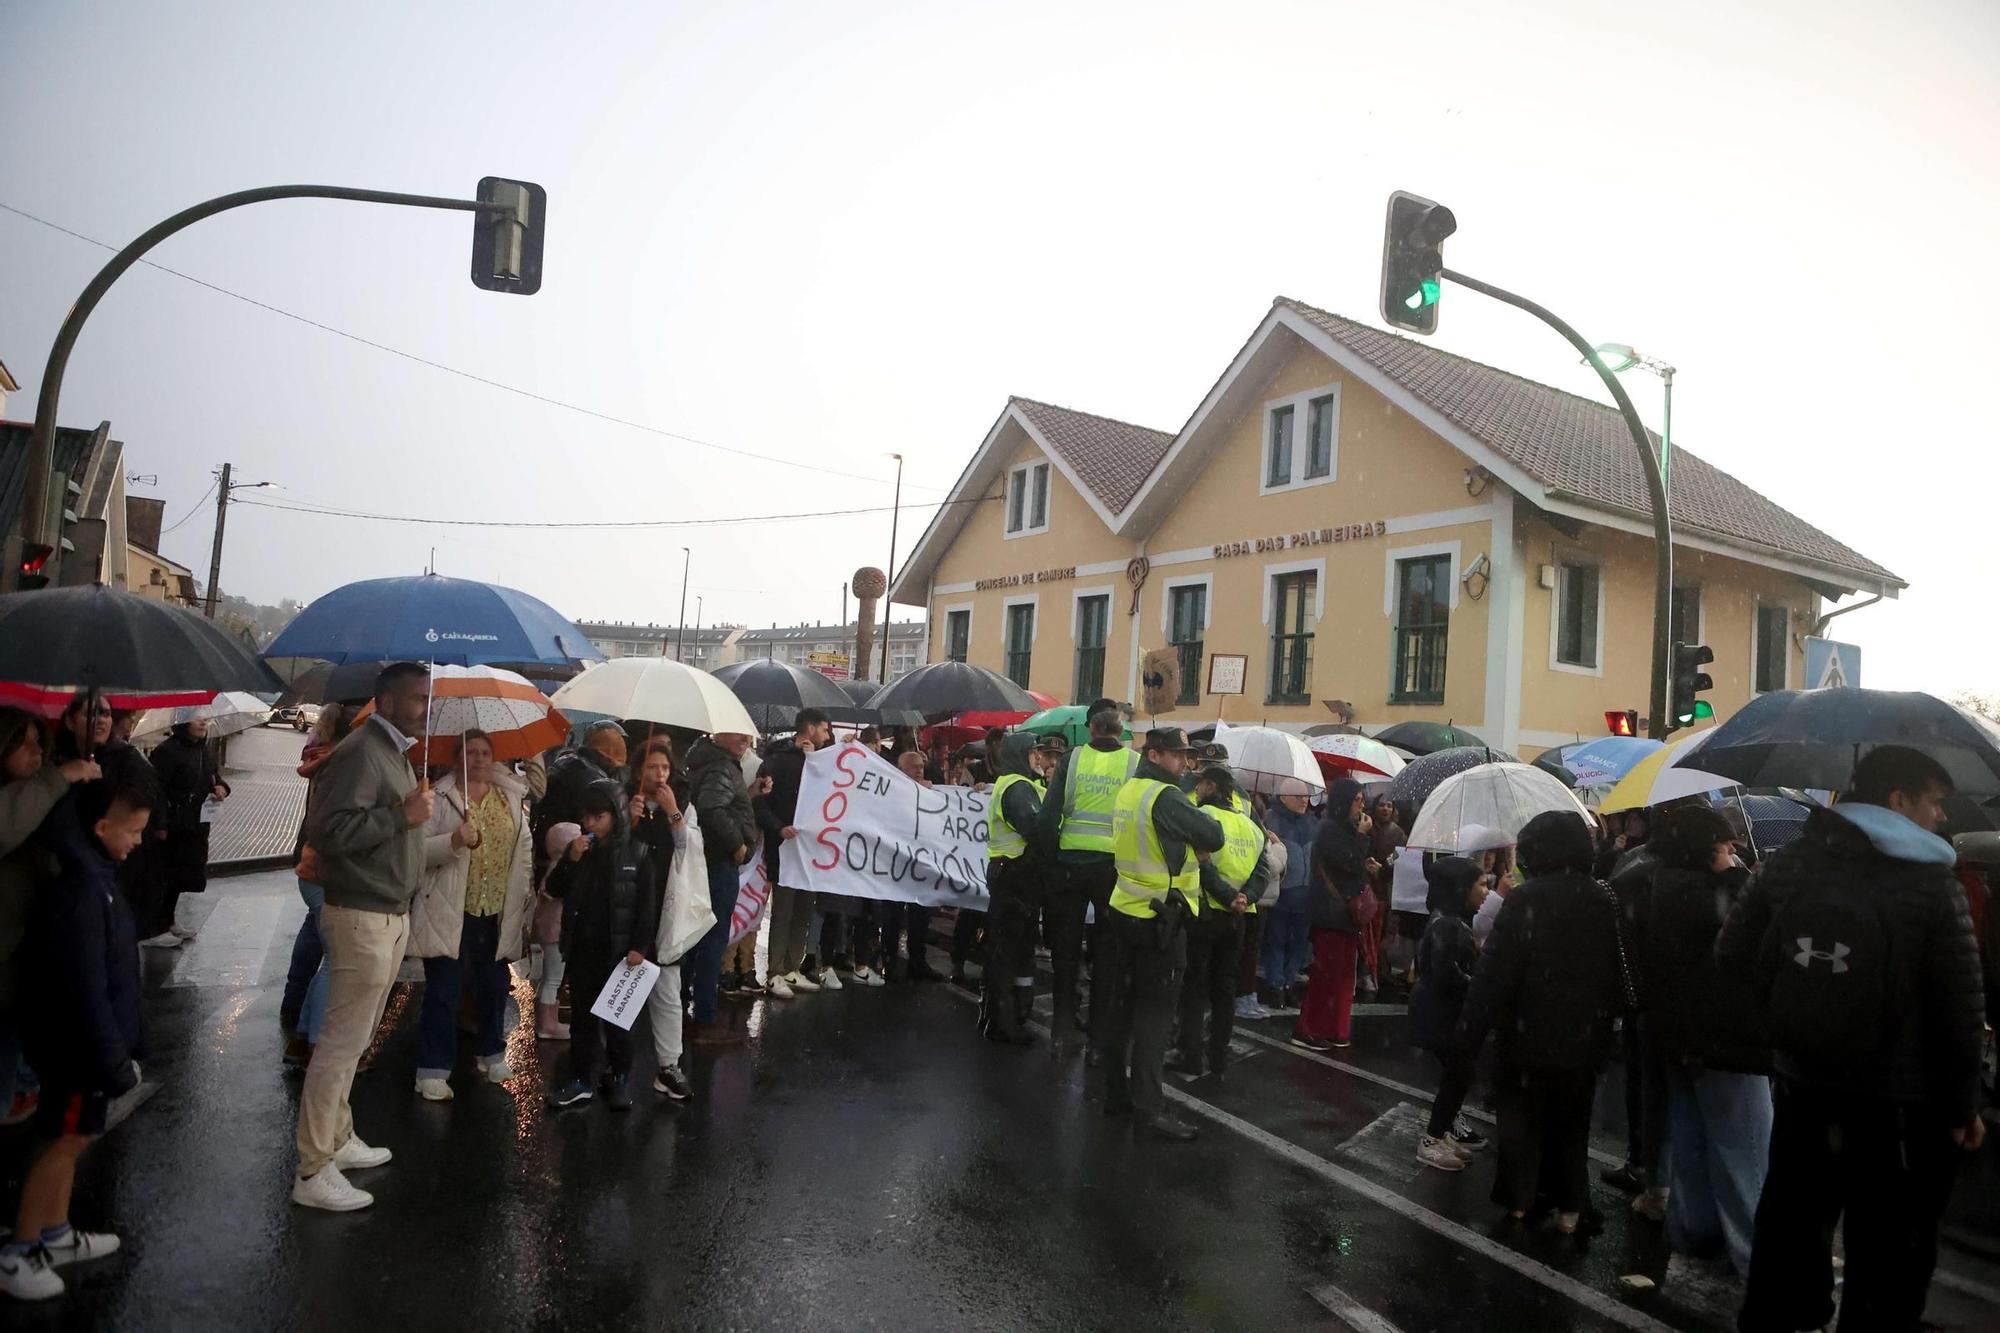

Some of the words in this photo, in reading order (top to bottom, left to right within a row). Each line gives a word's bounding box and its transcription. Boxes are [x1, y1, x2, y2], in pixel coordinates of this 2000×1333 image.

[1213, 541, 1250, 558] CASA
[1255, 536, 1285, 552] DAS
[1290, 520, 1386, 547] PALMEIRAS
[975, 575, 1020, 591] CONCELLO
[1022, 572, 1034, 585] DE
[1036, 566, 1077, 583] CAMBRE
[1077, 773, 1121, 786] GUARDIA
[1575, 770, 1609, 779] OLUCIO
[1085, 784, 1111, 795] CIVIL
[614, 966, 648, 1019] ABANDONO!
